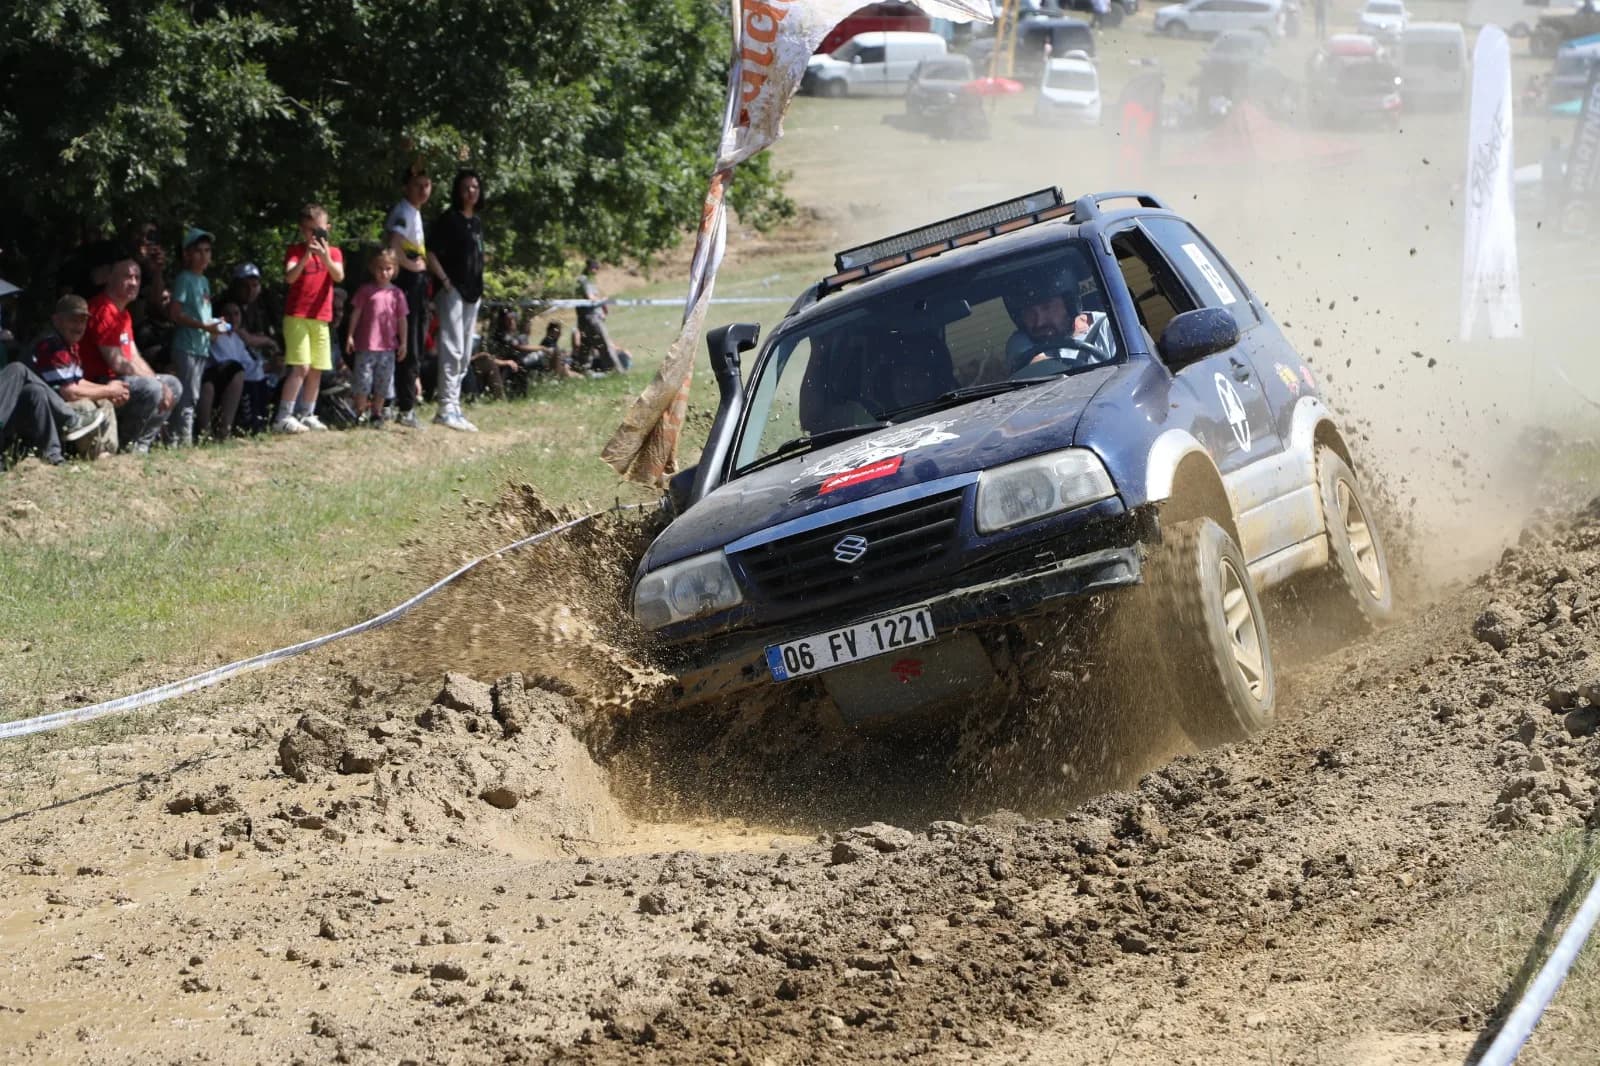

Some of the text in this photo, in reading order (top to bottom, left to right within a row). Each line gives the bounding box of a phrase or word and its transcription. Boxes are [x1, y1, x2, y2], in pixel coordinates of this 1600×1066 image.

[783, 611, 930, 674] 06 FV 1221
[771, 665, 785, 675] TR
